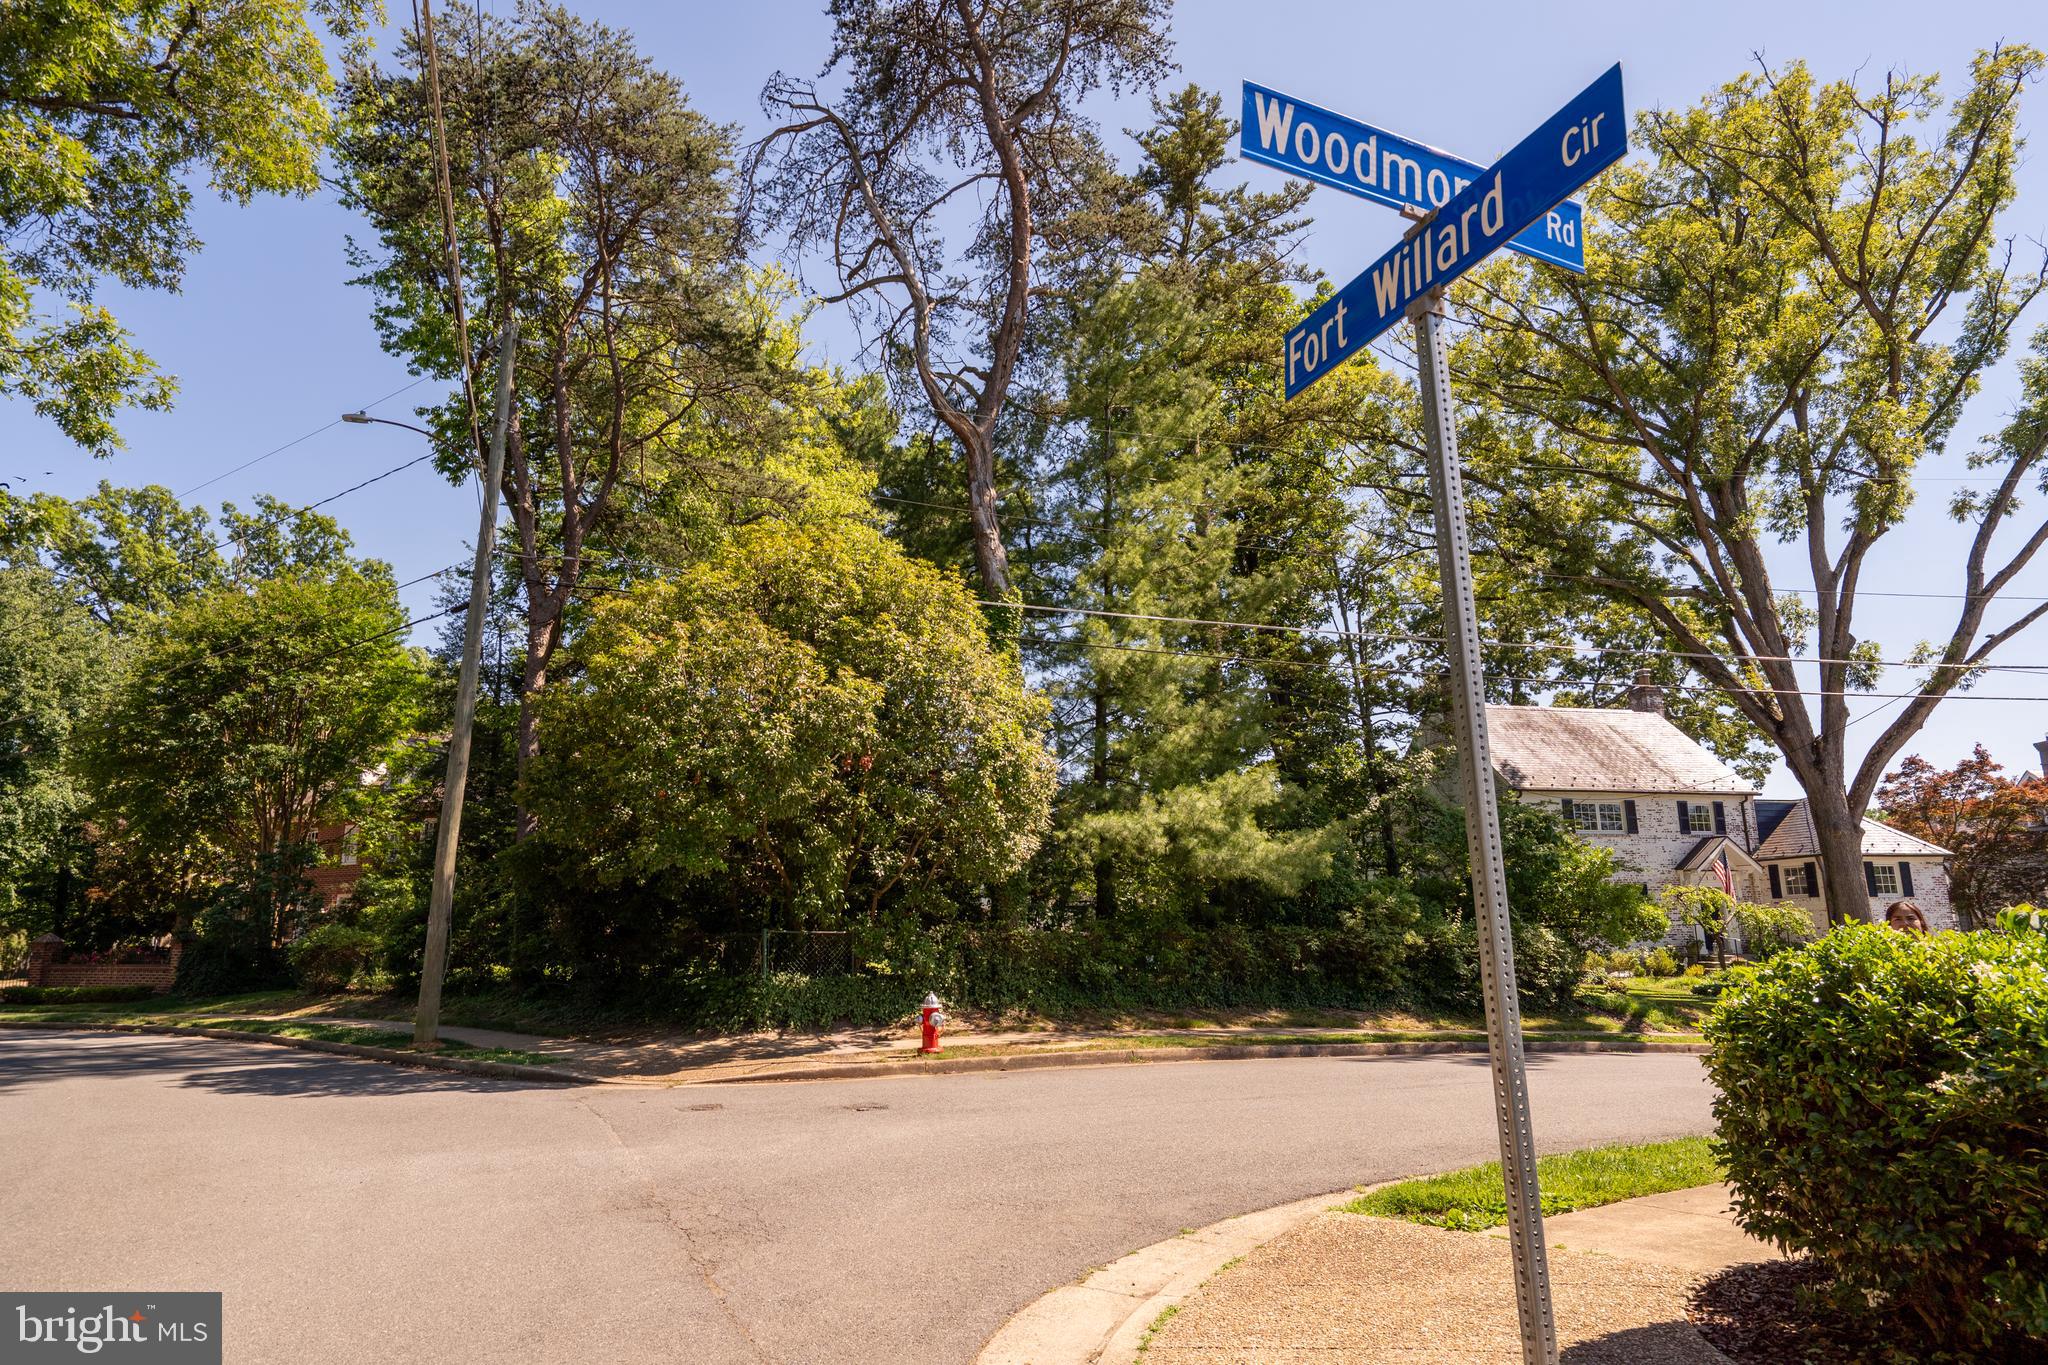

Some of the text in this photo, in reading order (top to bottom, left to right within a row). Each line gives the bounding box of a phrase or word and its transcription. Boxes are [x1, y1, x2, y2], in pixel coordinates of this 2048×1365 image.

[1289, 112, 1605, 386] Fort Willard Cir
[1546, 211, 1575, 248] Rd
